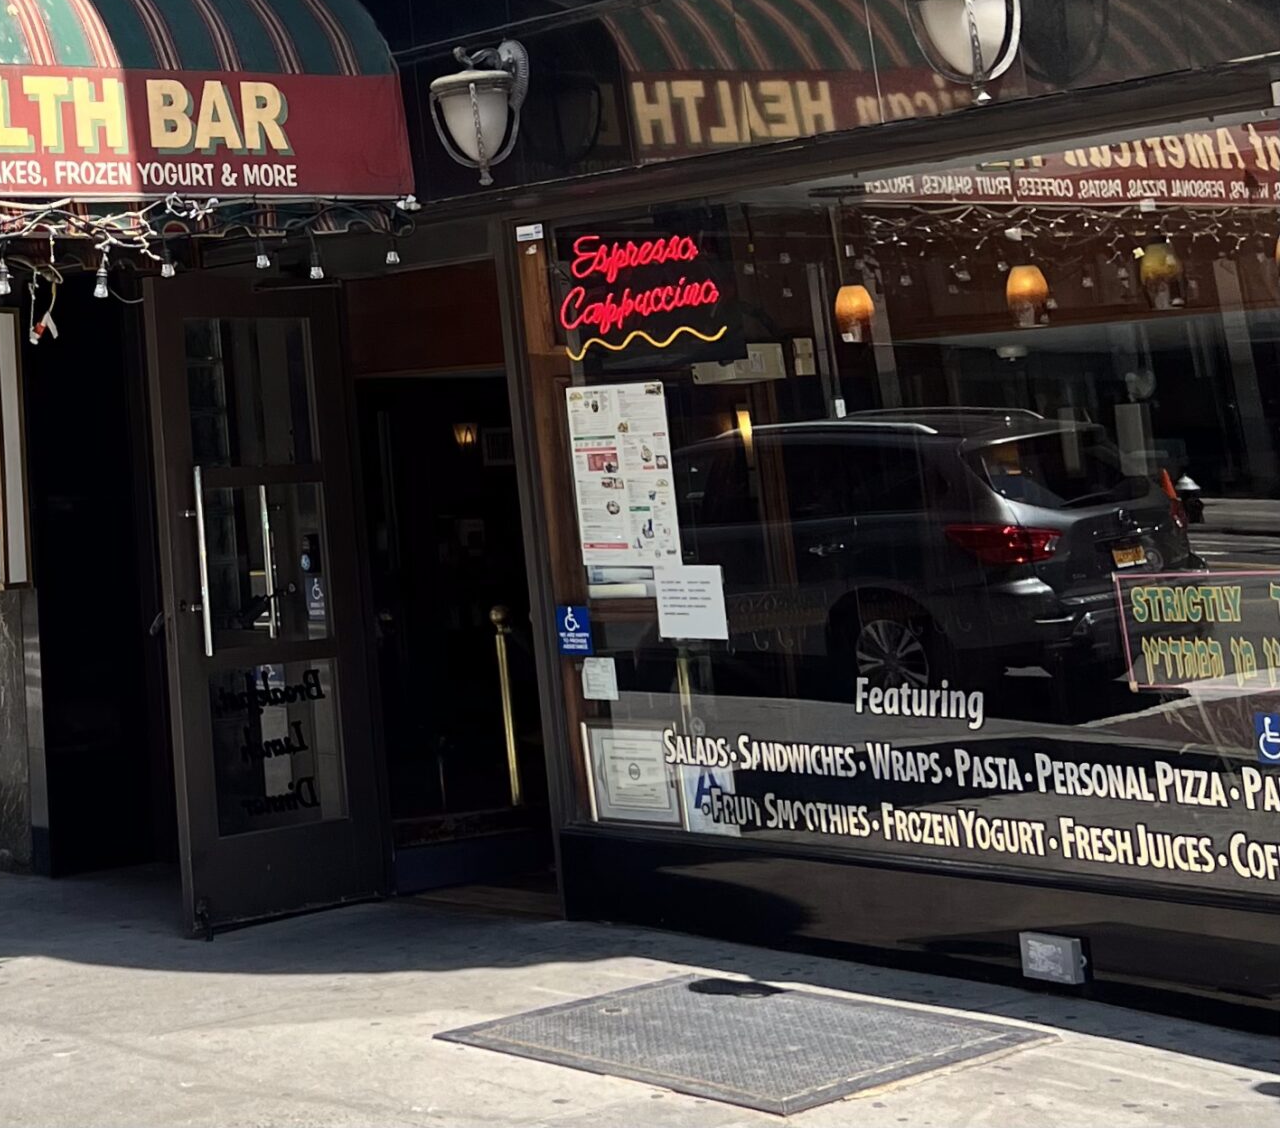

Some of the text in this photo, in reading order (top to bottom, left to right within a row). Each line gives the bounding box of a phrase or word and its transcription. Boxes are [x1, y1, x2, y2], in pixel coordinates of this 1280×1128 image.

[146, 78, 295, 156] BAR
[55, 160, 132, 185] FROZEN
[137, 162, 214, 187] YOGURT
[221, 163, 237, 187] &
[243, 163, 298, 187] MORE
[572, 234, 699, 284] Espresso
[560, 276, 720, 335] Cappuccino
[1130, 585, 1242, 623] STRICTLY
[855, 676, 985, 730] Featuring
[865, 741, 944, 784] WRAPS
[953, 748, 1024, 791] PASTA
[1034, 752, 1155, 803] PERSONAL
[1154, 760, 1229, 808] PIZZA
[880, 802, 960, 848] FROZEN
[957, 809, 1047, 856] YOGURT
[1058, 817, 1136, 865] FRESH
[1135, 824, 1216, 873] JUICES
